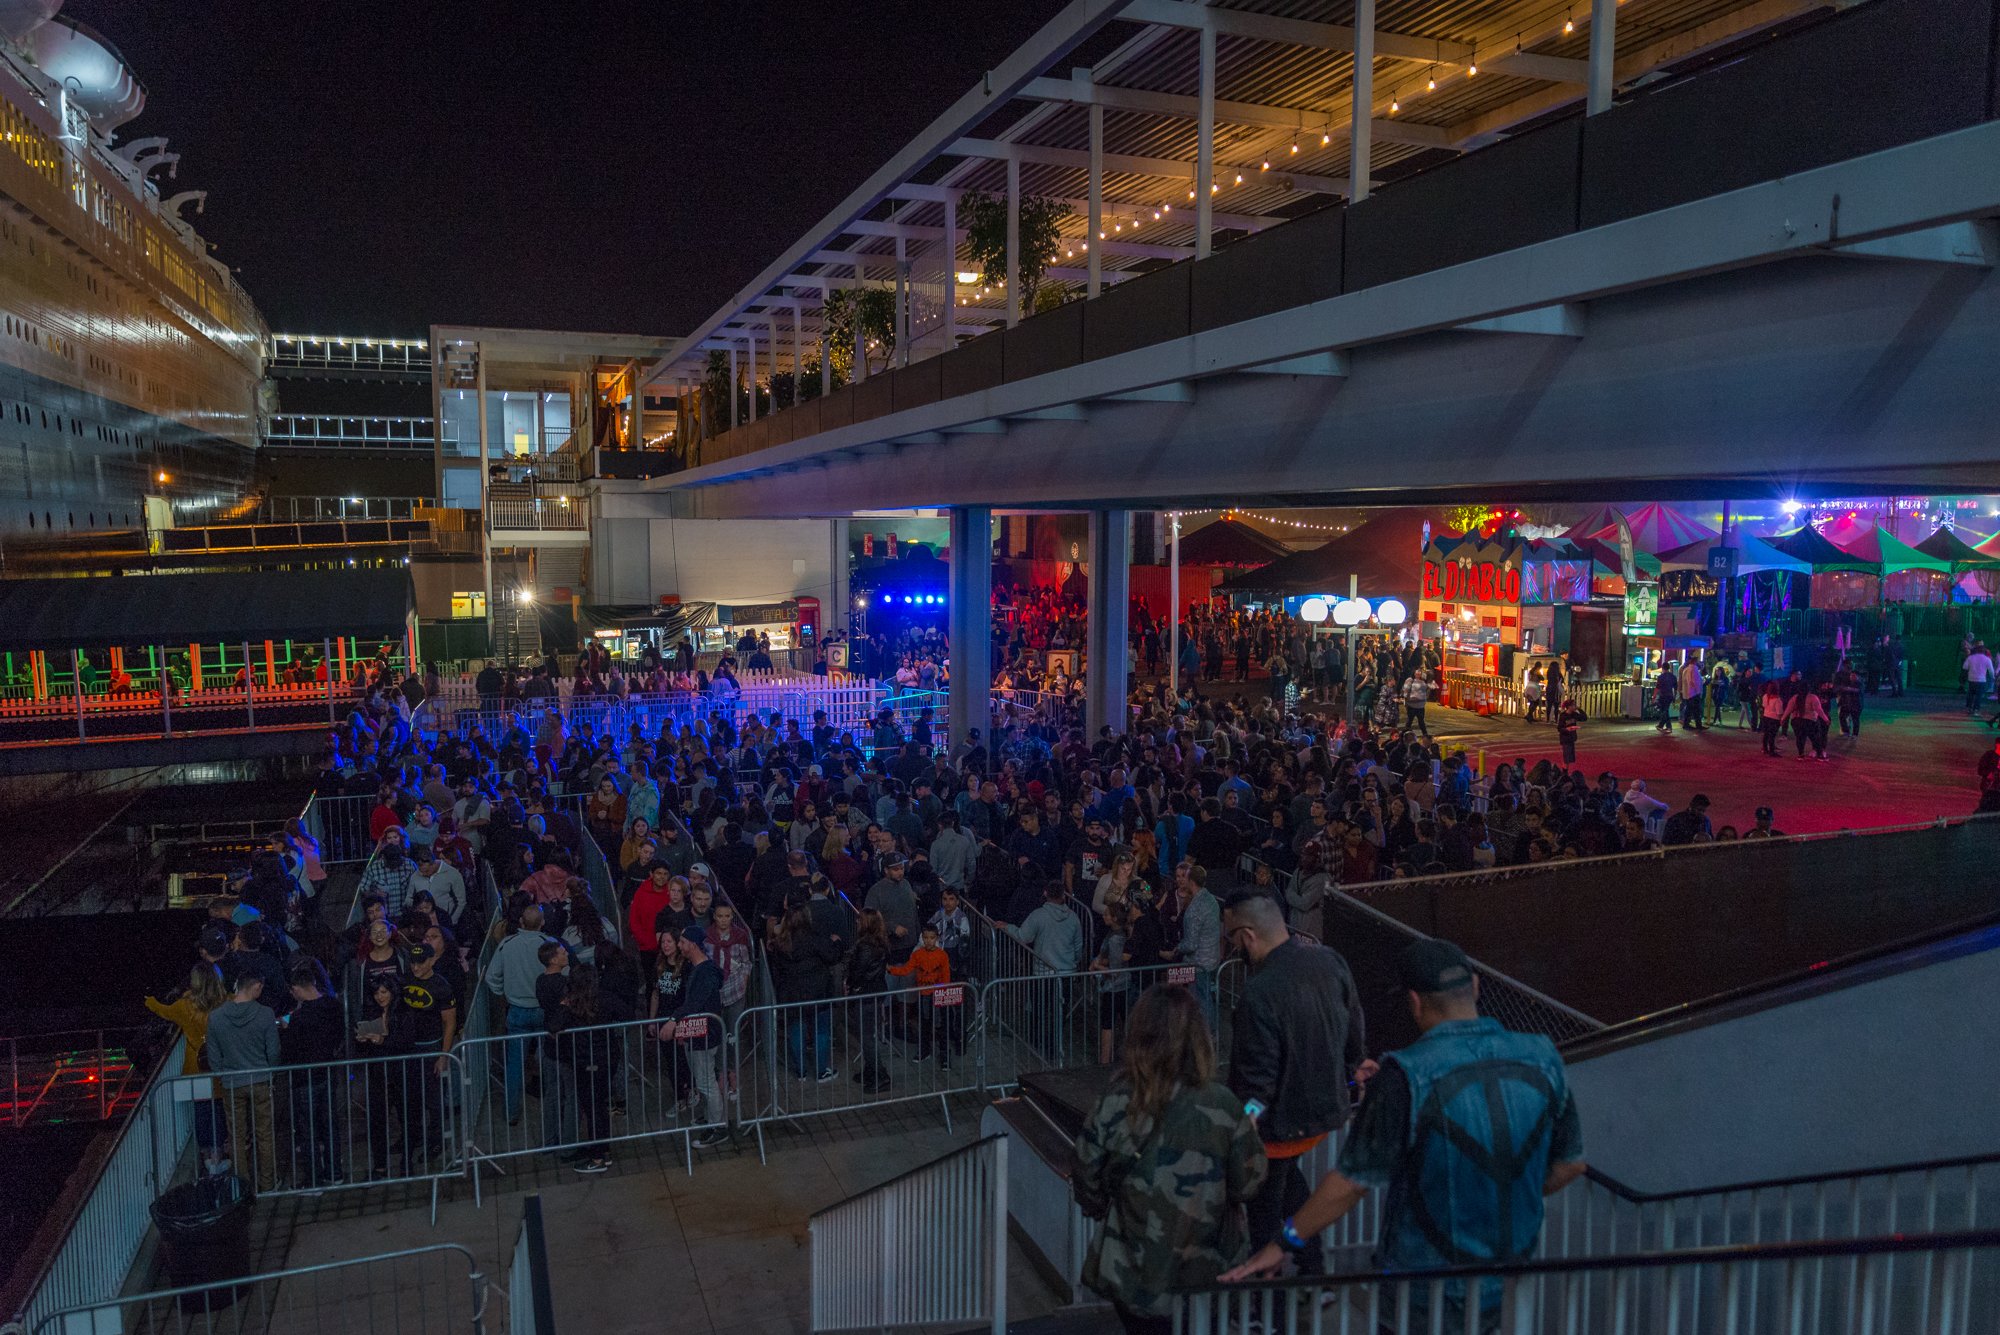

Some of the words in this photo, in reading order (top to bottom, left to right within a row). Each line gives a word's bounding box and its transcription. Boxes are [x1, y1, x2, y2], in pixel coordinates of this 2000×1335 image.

[1423, 560, 1444, 600] EL
[1443, 560, 1521, 604] DIABLO
[761, 606, 798, 622] TAMALES
[1635, 586, 1651, 623] ATM
[833, 650, 842, 663] C
